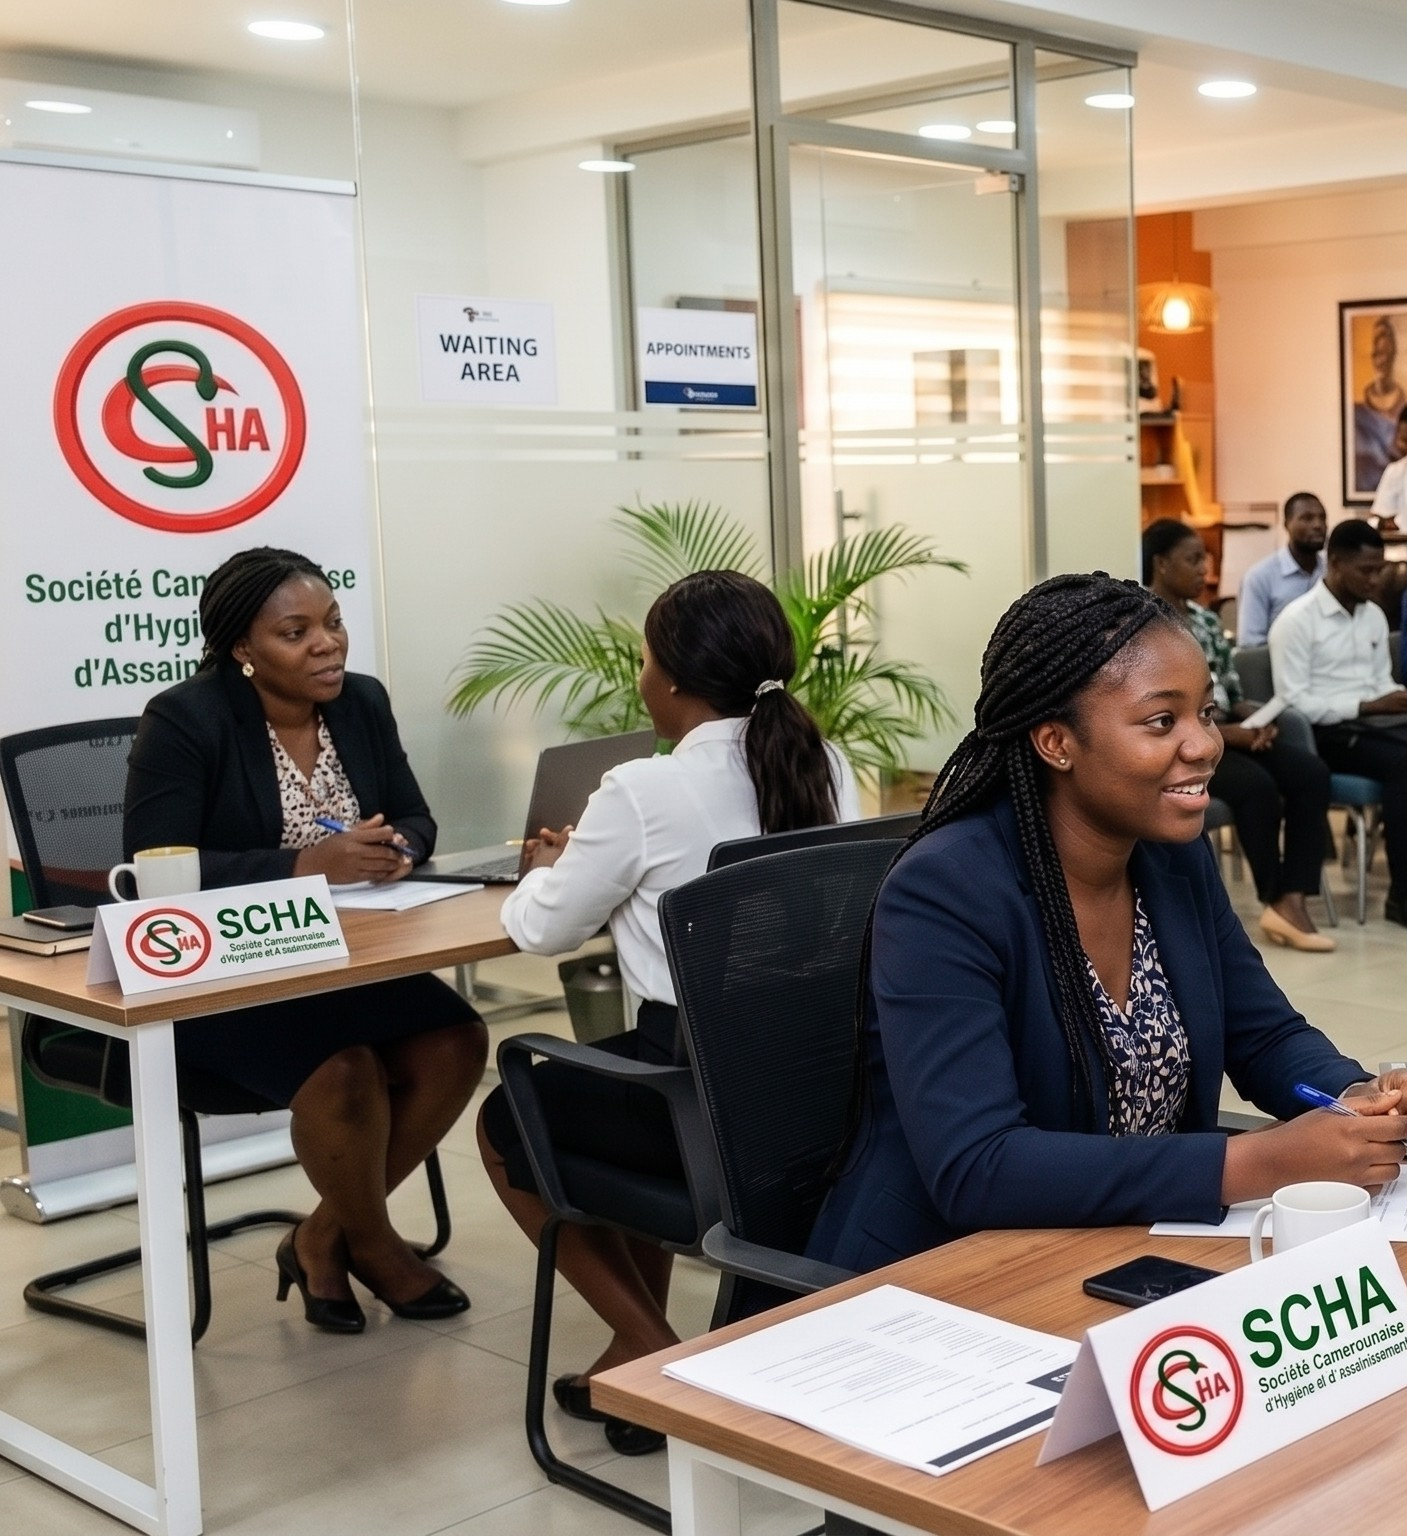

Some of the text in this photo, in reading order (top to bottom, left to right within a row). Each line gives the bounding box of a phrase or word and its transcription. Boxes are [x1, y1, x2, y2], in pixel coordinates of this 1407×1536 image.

[440, 333, 538, 357] WAITING
[647, 341, 751, 360] APPOINTMENTS
[461, 362, 521, 383] AREA
[25, 568, 142, 603] Société
[105, 610, 199, 647] d'Hygi
[217, 897, 331, 939] SCHA
[1242, 1265, 1398, 1369] SCHA
[1258, 1321, 1405, 1393] Société Camerounaise
